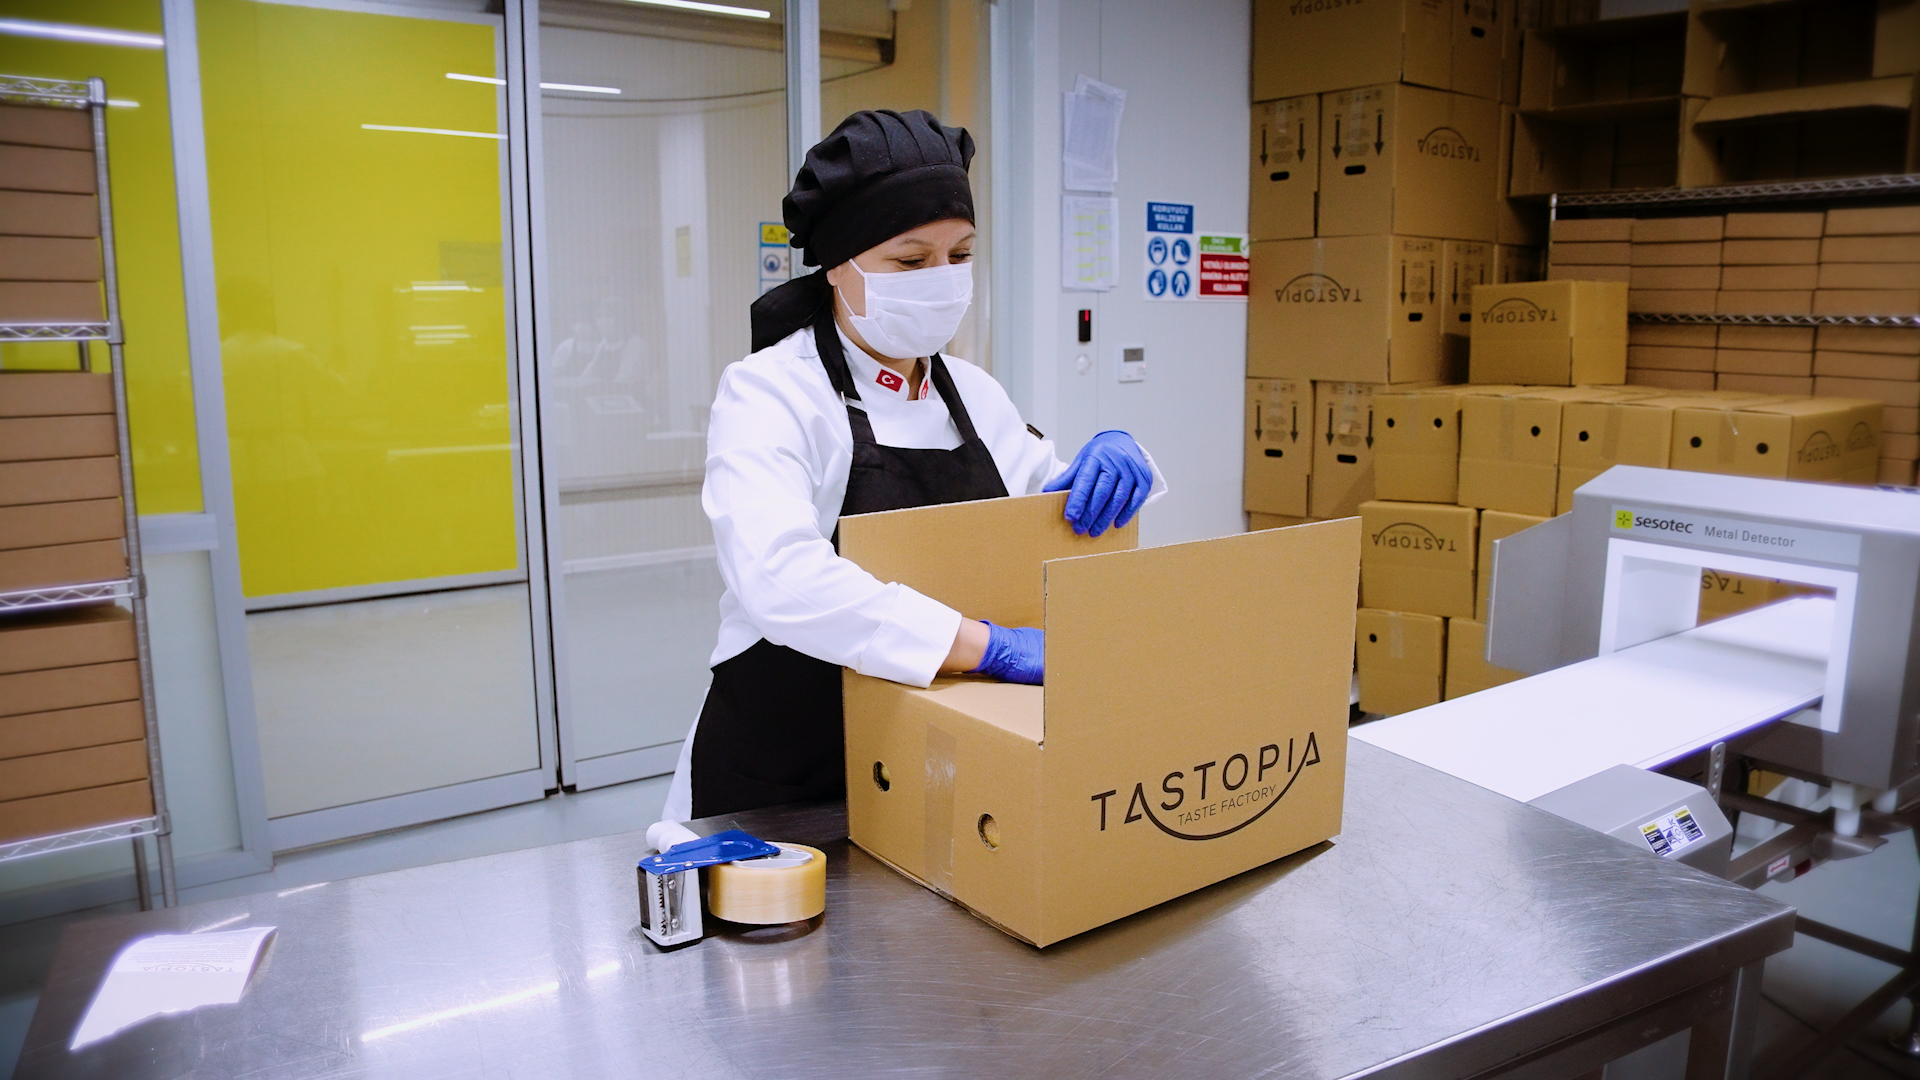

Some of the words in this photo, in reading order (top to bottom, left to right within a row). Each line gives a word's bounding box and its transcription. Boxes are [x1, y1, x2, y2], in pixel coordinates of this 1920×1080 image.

[1417, 139, 1481, 161] TASTOPIA
[1274, 288, 1361, 303] TASTOPIA
[1481, 309, 1557, 324] TASTOPIA
[1635, 515, 1694, 533] sesotec
[1704, 525, 1738, 540] Metal
[1742, 530, 1796, 547] Detector
[1371, 534, 1456, 551] TASTOPIA
[1702, 575, 1744, 595] TAS
[1091, 731, 1321, 831] TASTOPIA
[1178, 803, 1217, 826] TASTE
[1221, 784, 1277, 813] FACTORY
